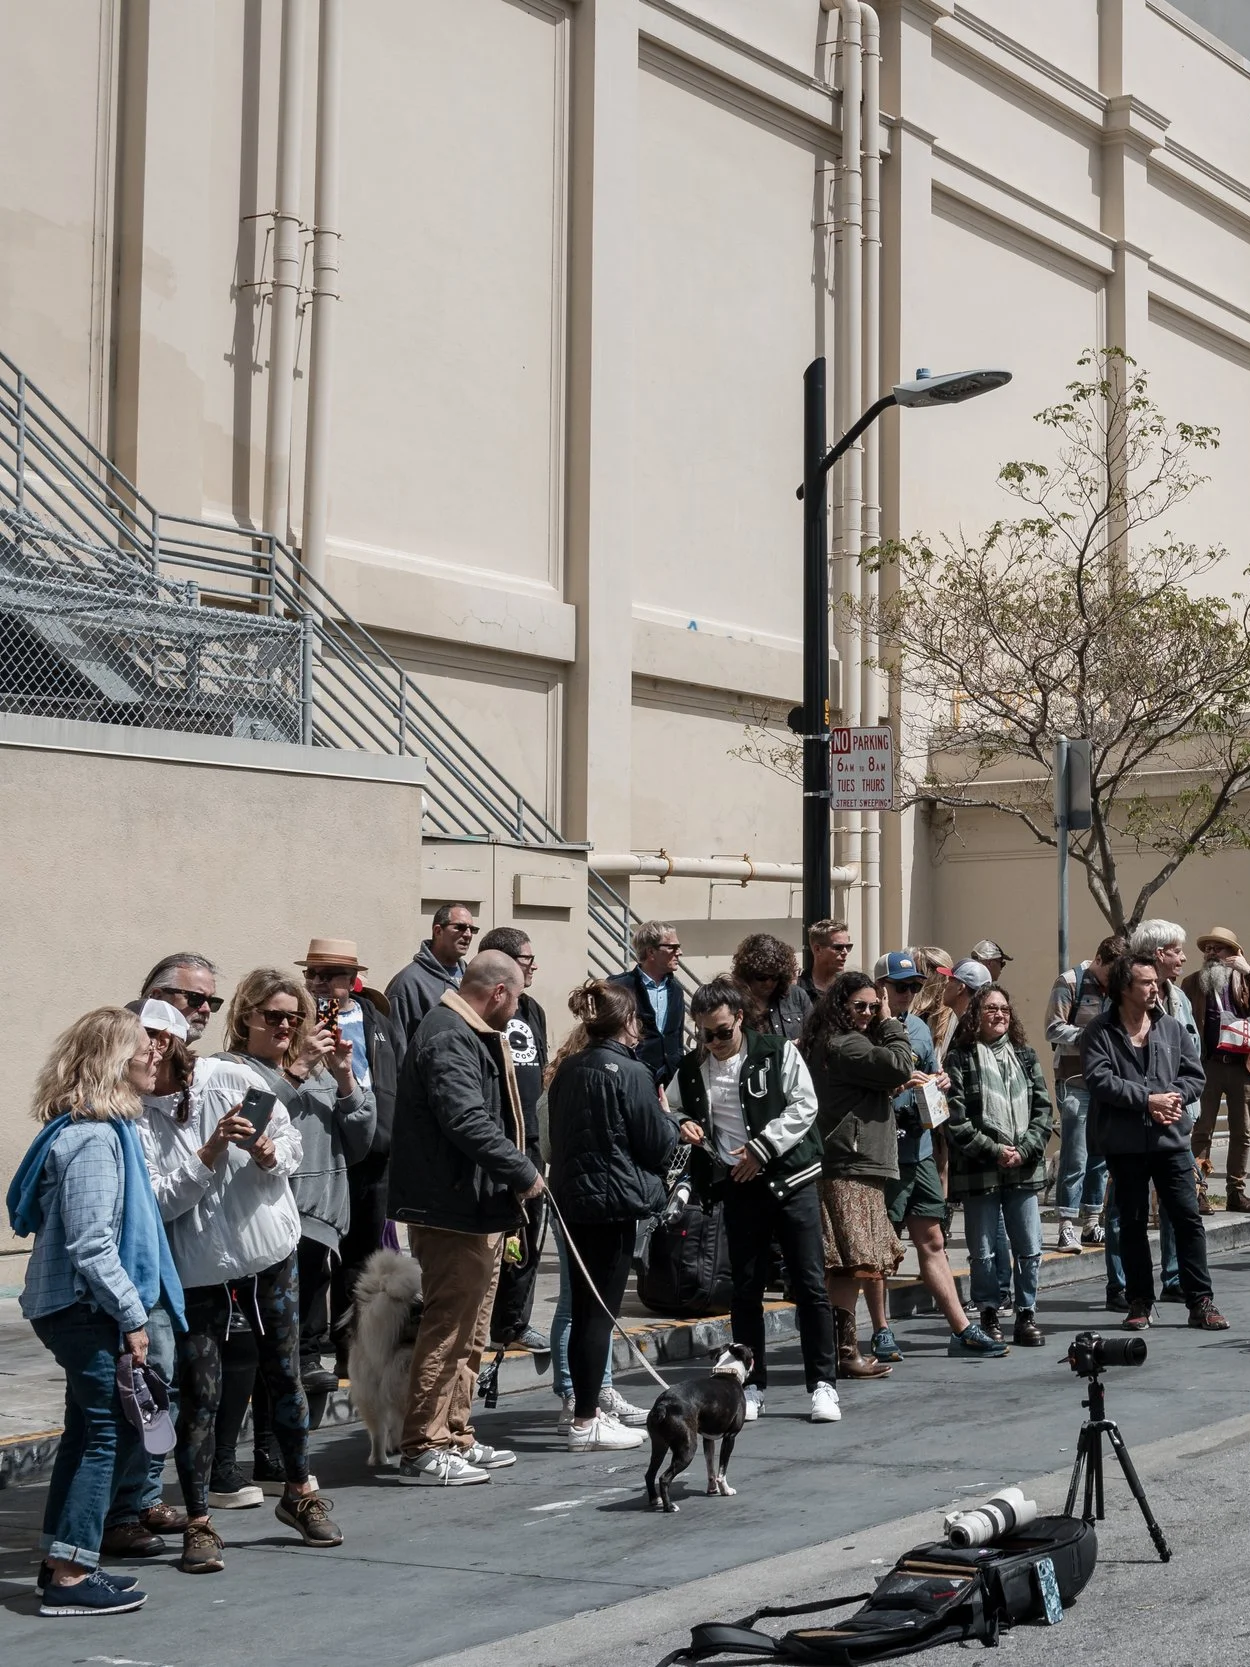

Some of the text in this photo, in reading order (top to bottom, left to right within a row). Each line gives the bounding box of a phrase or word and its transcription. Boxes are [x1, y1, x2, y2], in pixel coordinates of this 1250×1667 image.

[833, 730, 889, 751] NO PARKING
[837, 757, 855, 772] 6AM
[868, 756, 886, 772] 8AM
[838, 779, 885, 792] TUES THURS
[836, 799, 888, 808] STREET SWEEPING
